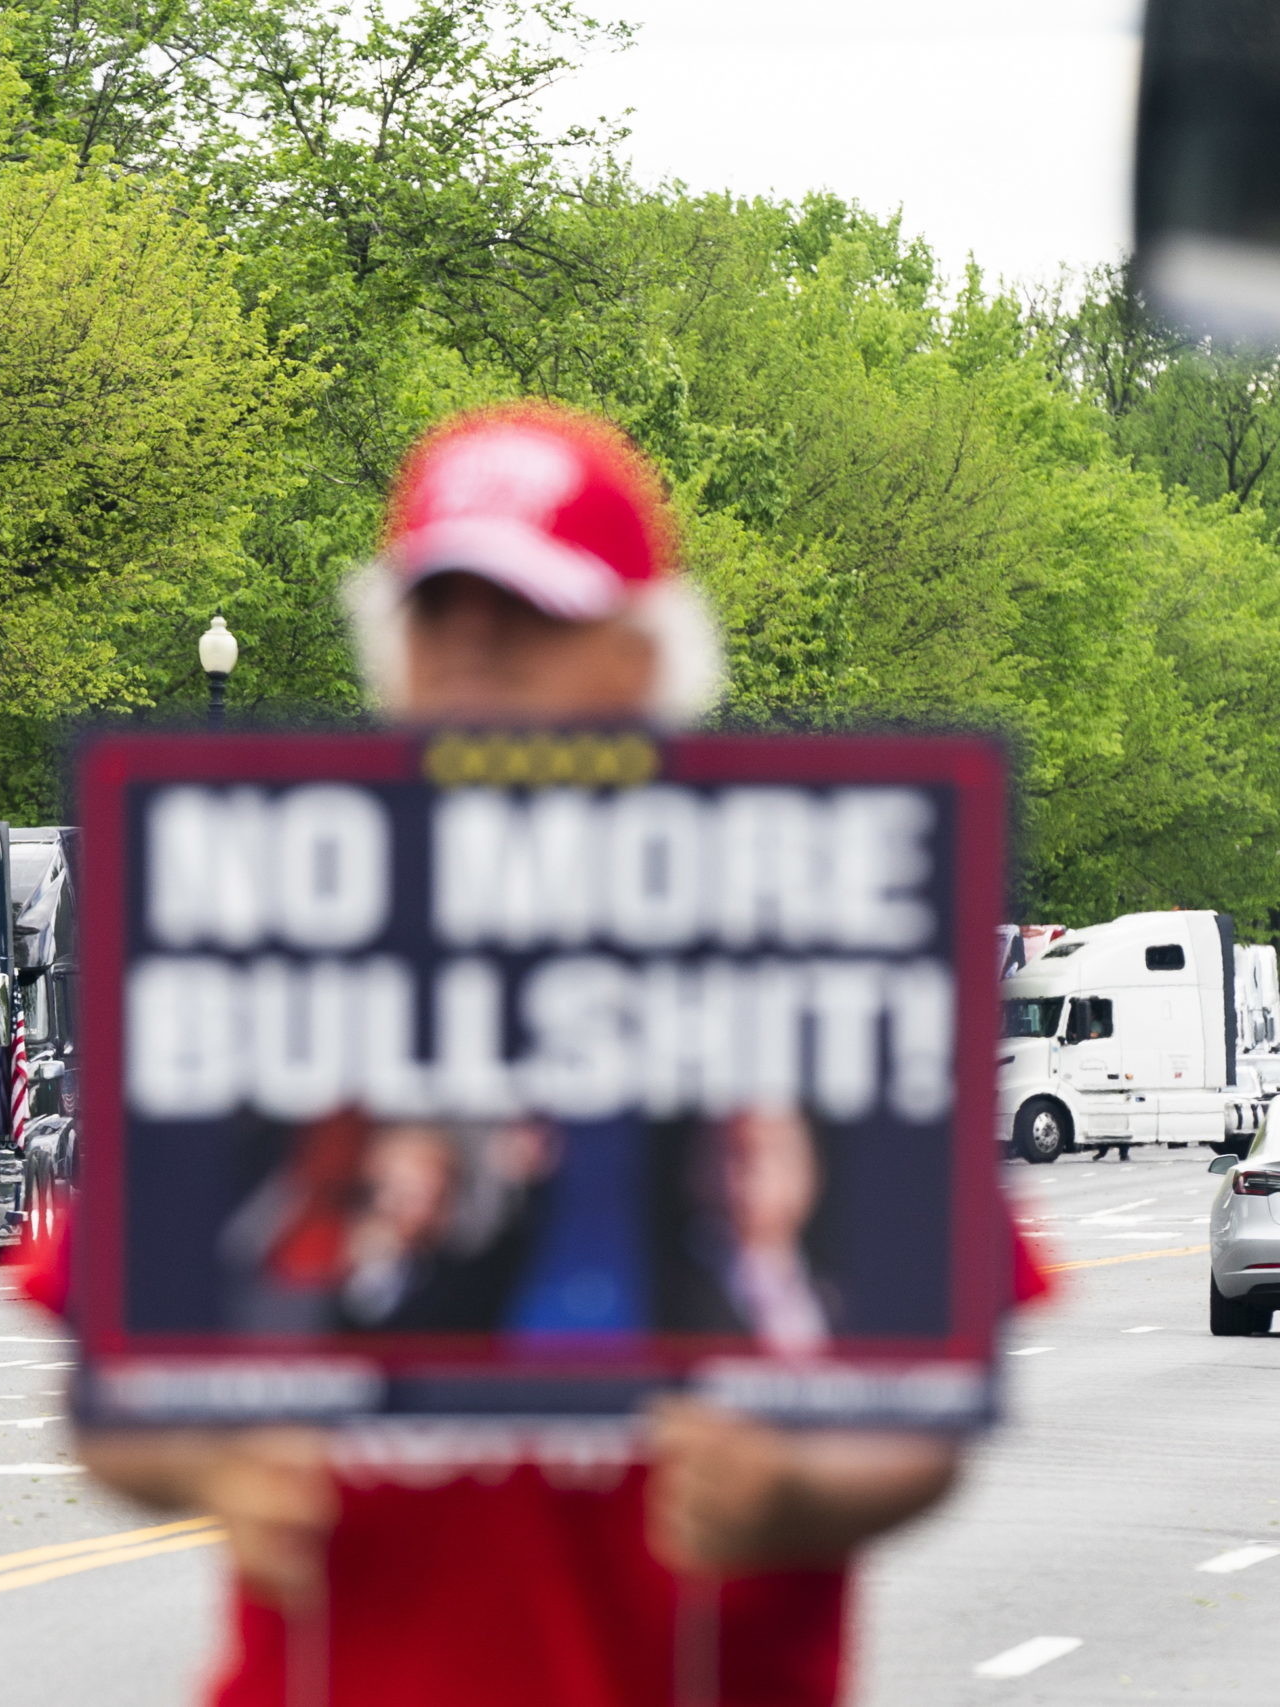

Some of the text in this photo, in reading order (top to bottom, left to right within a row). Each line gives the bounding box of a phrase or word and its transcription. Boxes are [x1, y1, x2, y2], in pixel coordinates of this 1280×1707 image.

[152, 786, 935, 948] NO MORE
[127, 957, 954, 1120] BULLSHIT!
